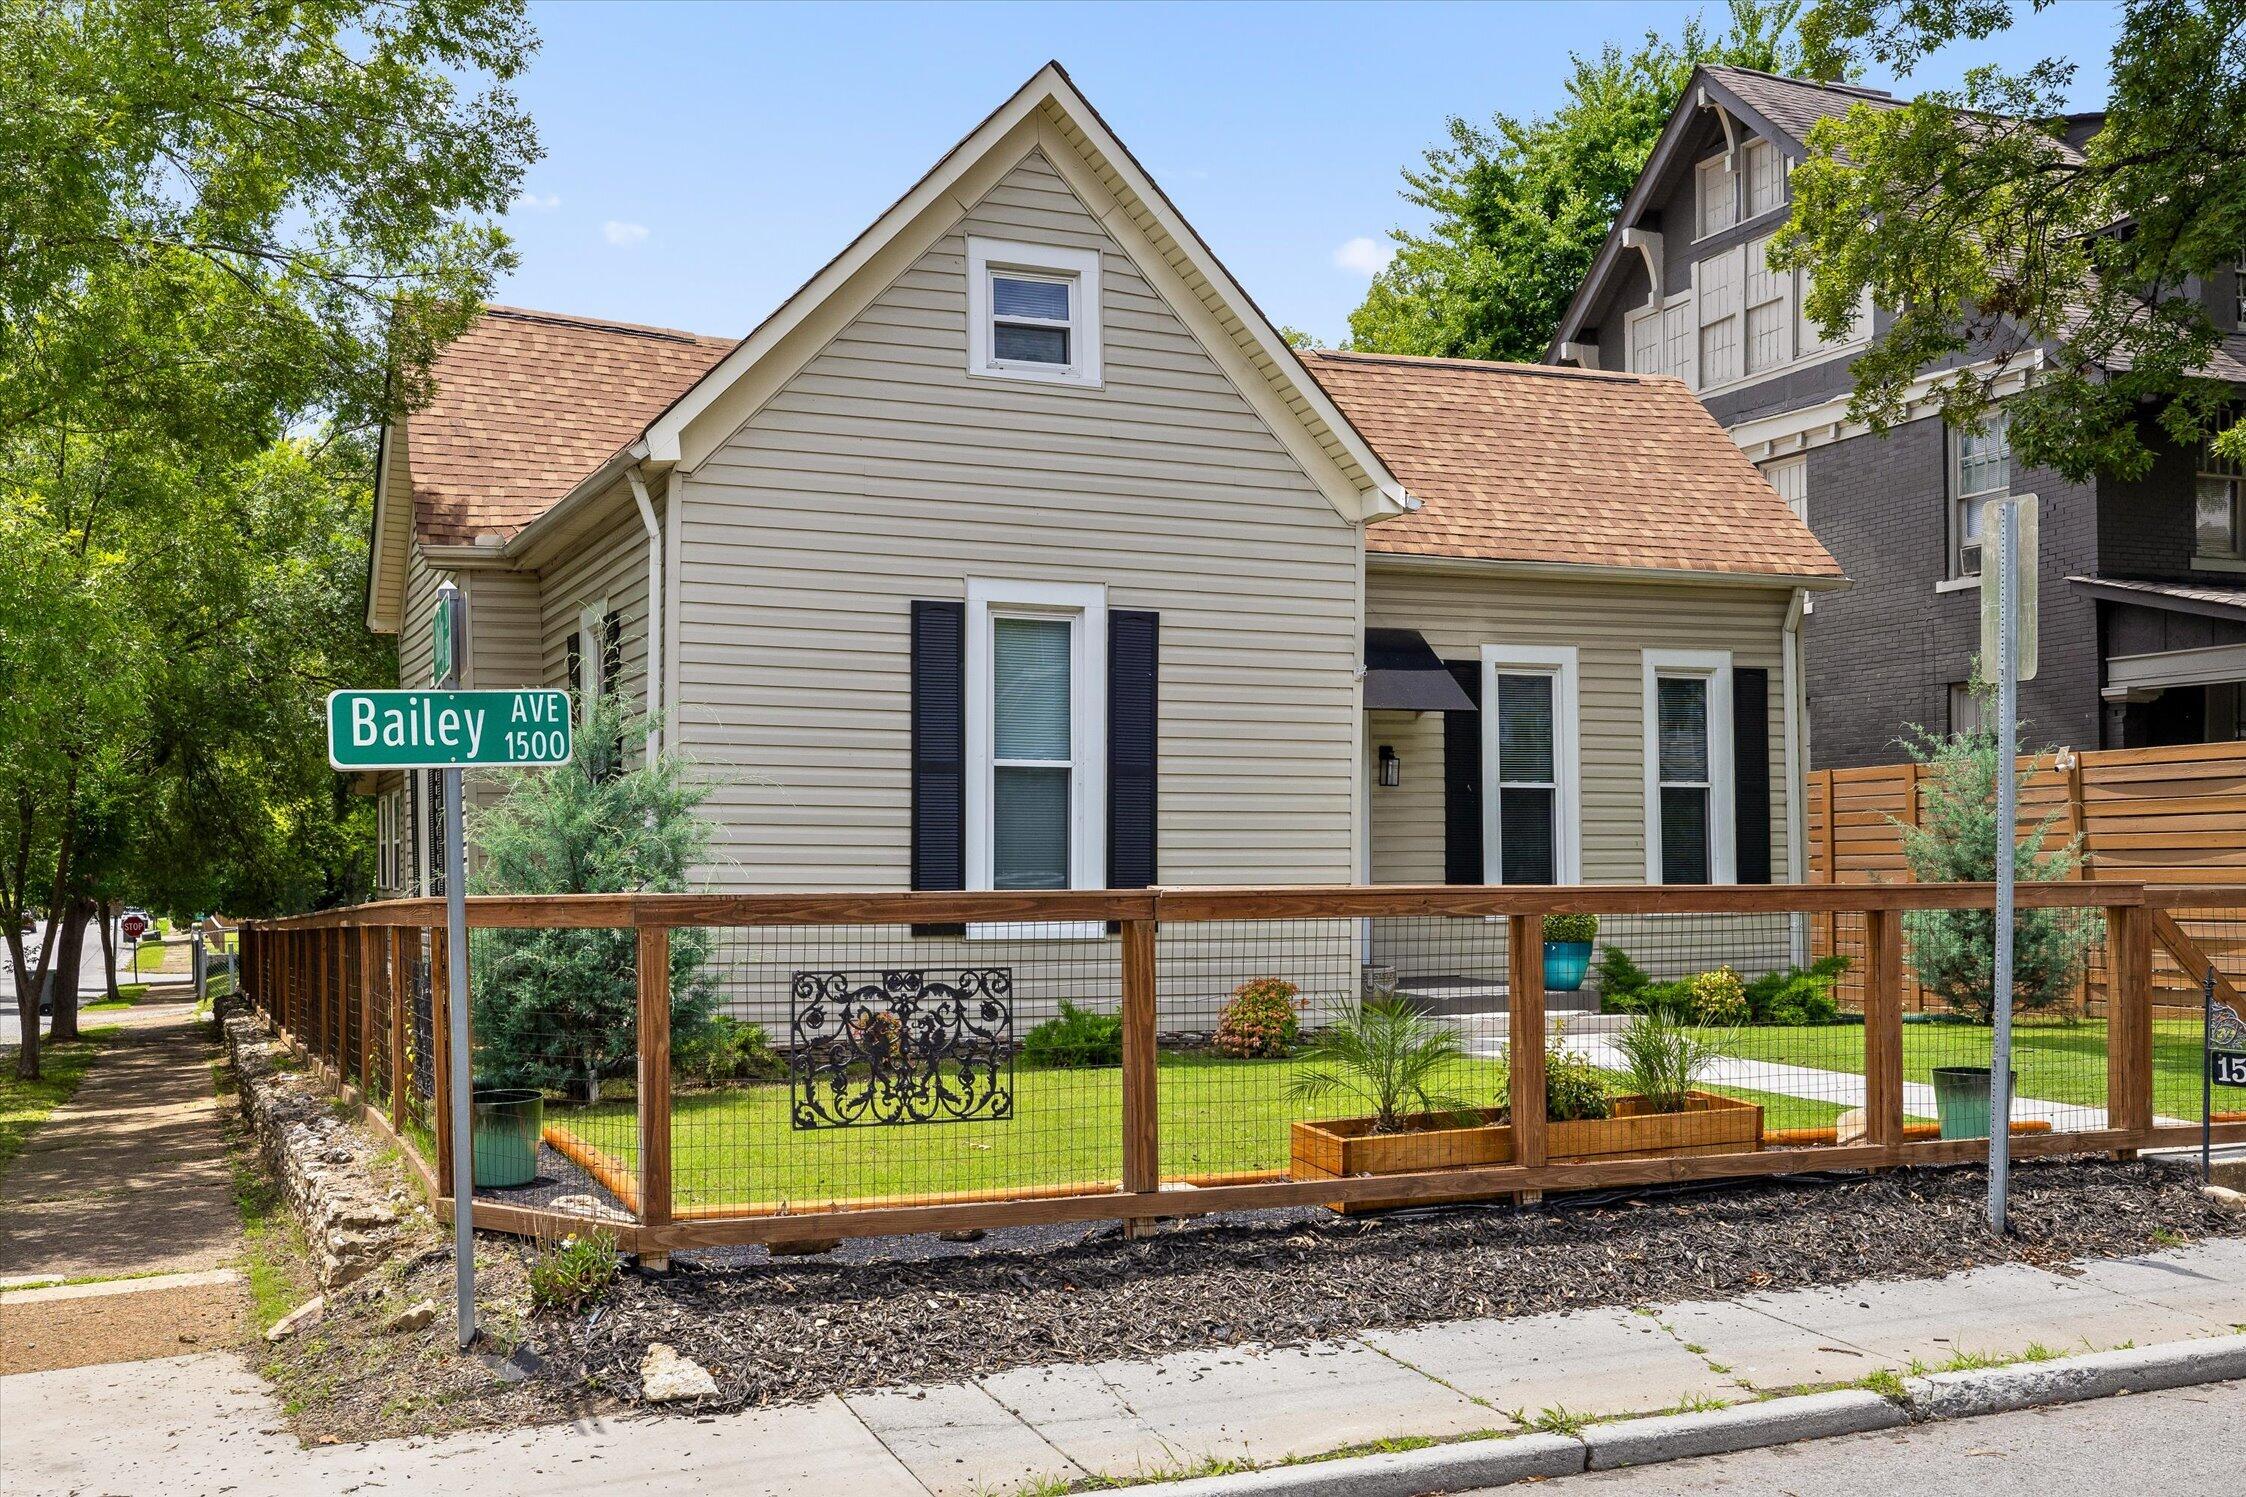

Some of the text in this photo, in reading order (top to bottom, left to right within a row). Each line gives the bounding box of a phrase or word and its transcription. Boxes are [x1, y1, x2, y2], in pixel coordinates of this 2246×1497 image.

[351, 694, 560, 759] Bailey AVE
[504, 731, 565, 760] 1500
[124, 922, 144, 931] STOP
